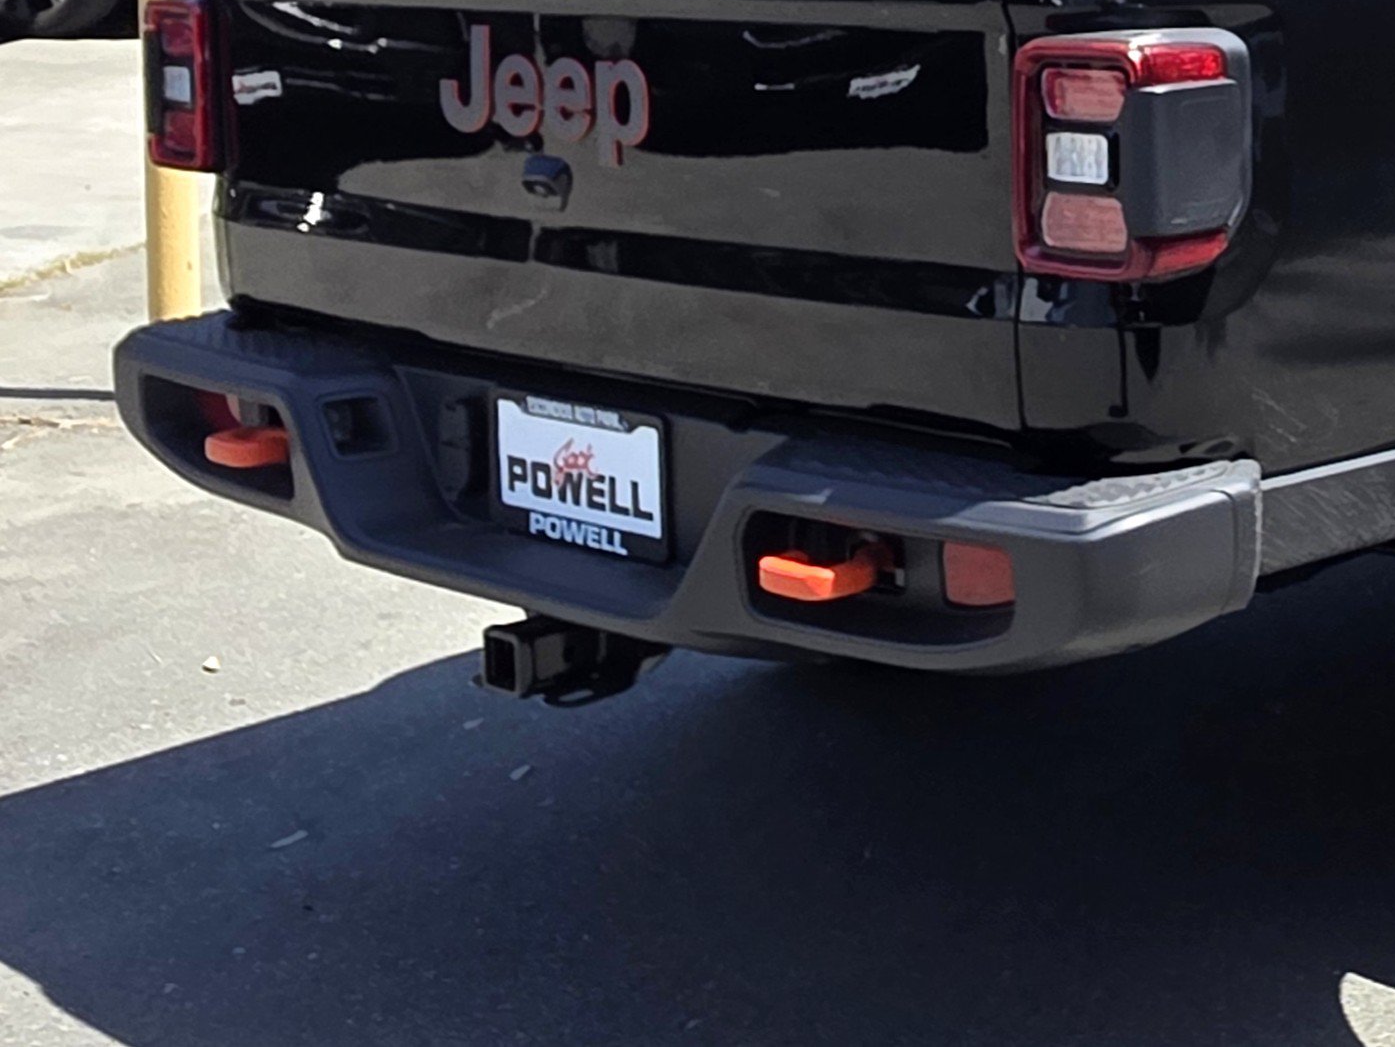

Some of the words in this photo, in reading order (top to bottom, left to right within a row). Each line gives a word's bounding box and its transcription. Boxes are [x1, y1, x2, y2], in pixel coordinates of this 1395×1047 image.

[439, 24, 649, 167] Jeep
[507, 455, 654, 521] POWELL
[529, 511, 628, 556] POWELL
